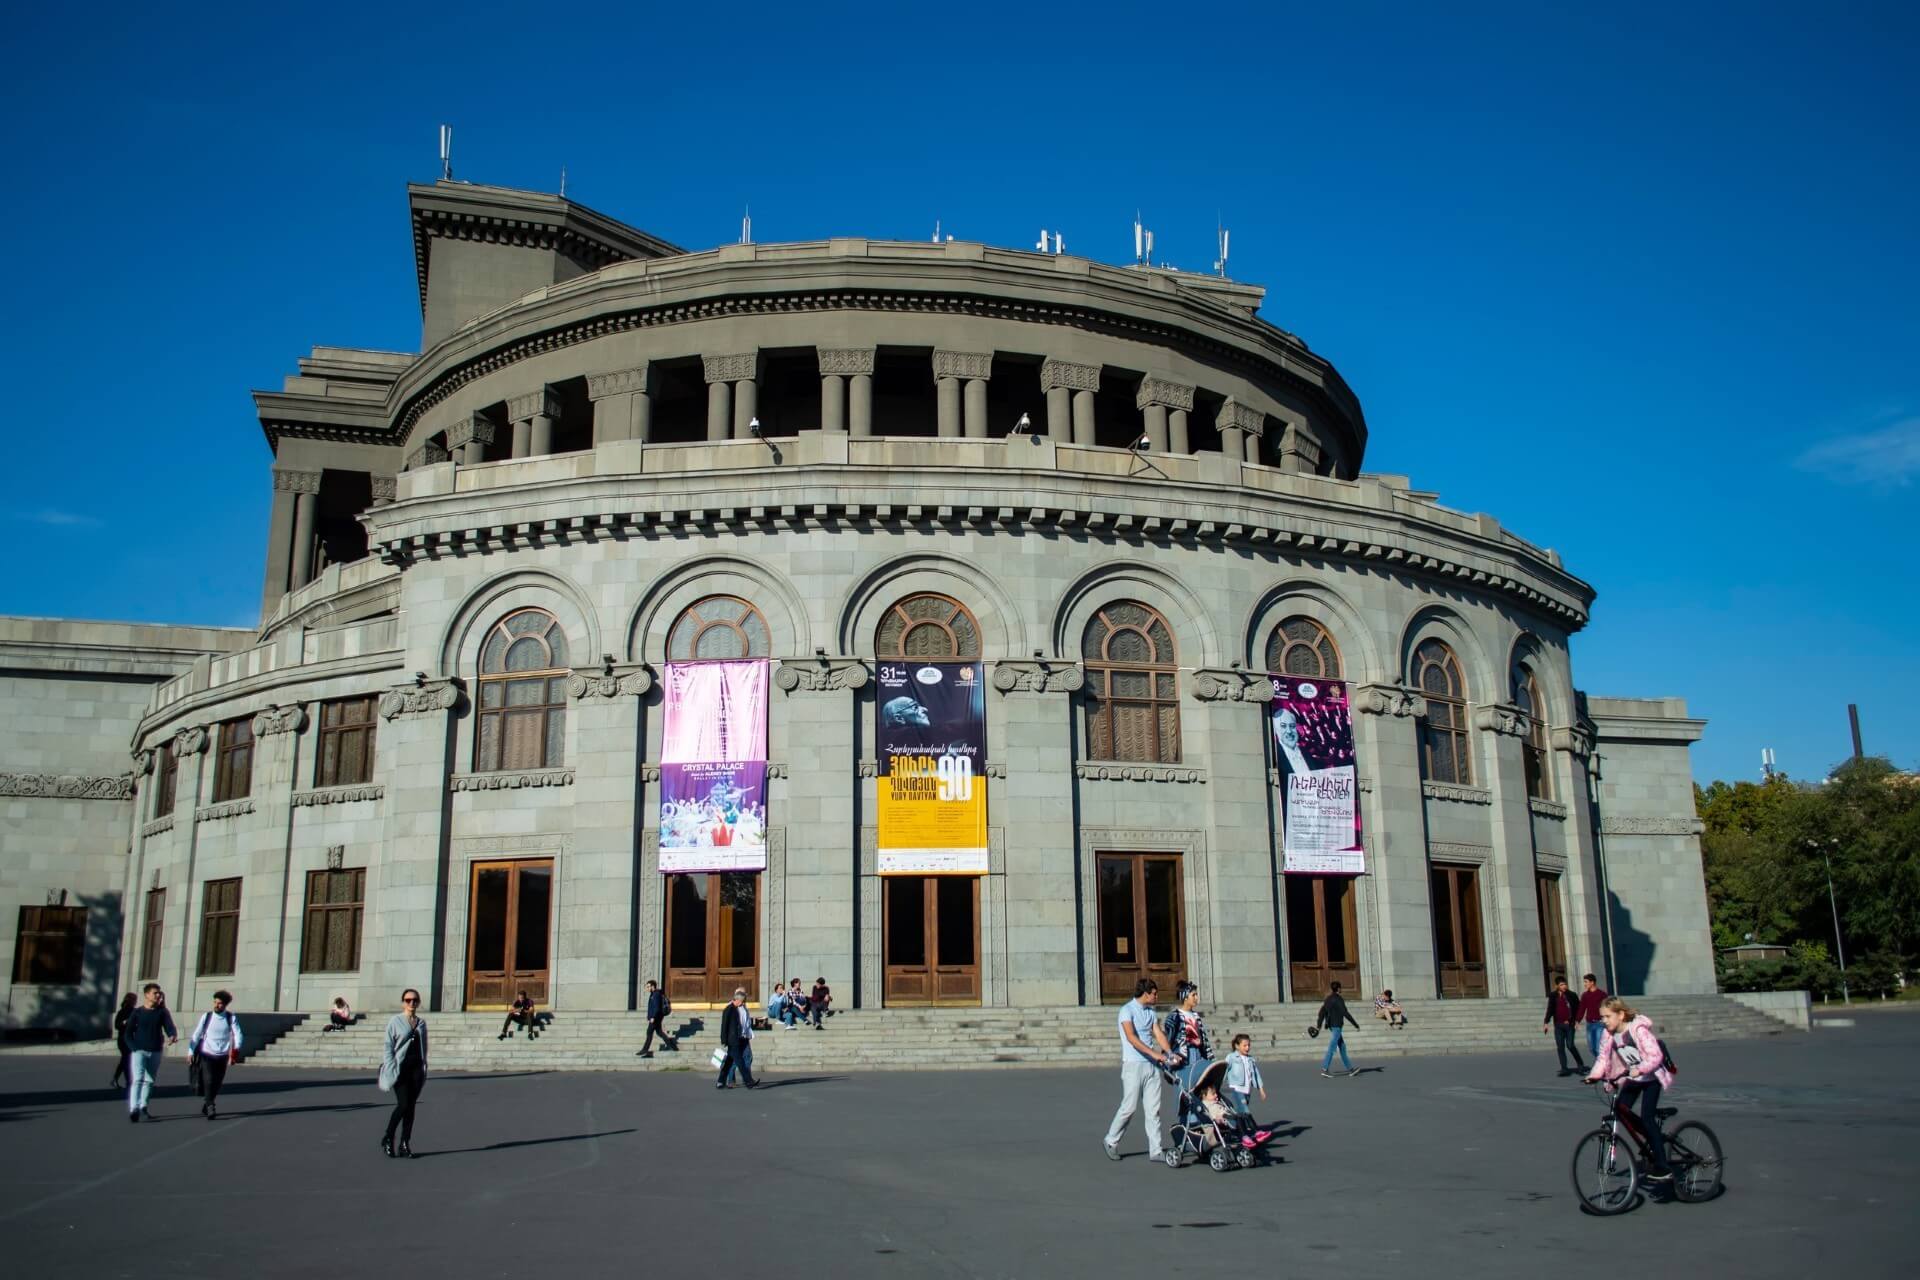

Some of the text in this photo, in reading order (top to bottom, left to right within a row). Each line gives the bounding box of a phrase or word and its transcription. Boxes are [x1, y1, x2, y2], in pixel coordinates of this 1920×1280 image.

[881, 667, 896, 679] 31
[1273, 680, 1280, 691] 8
[682, 762, 745, 772] CRYSTAL PALACE
[938, 755, 972, 801] 90
[891, 791, 937, 801] YURY DAVTYAN
